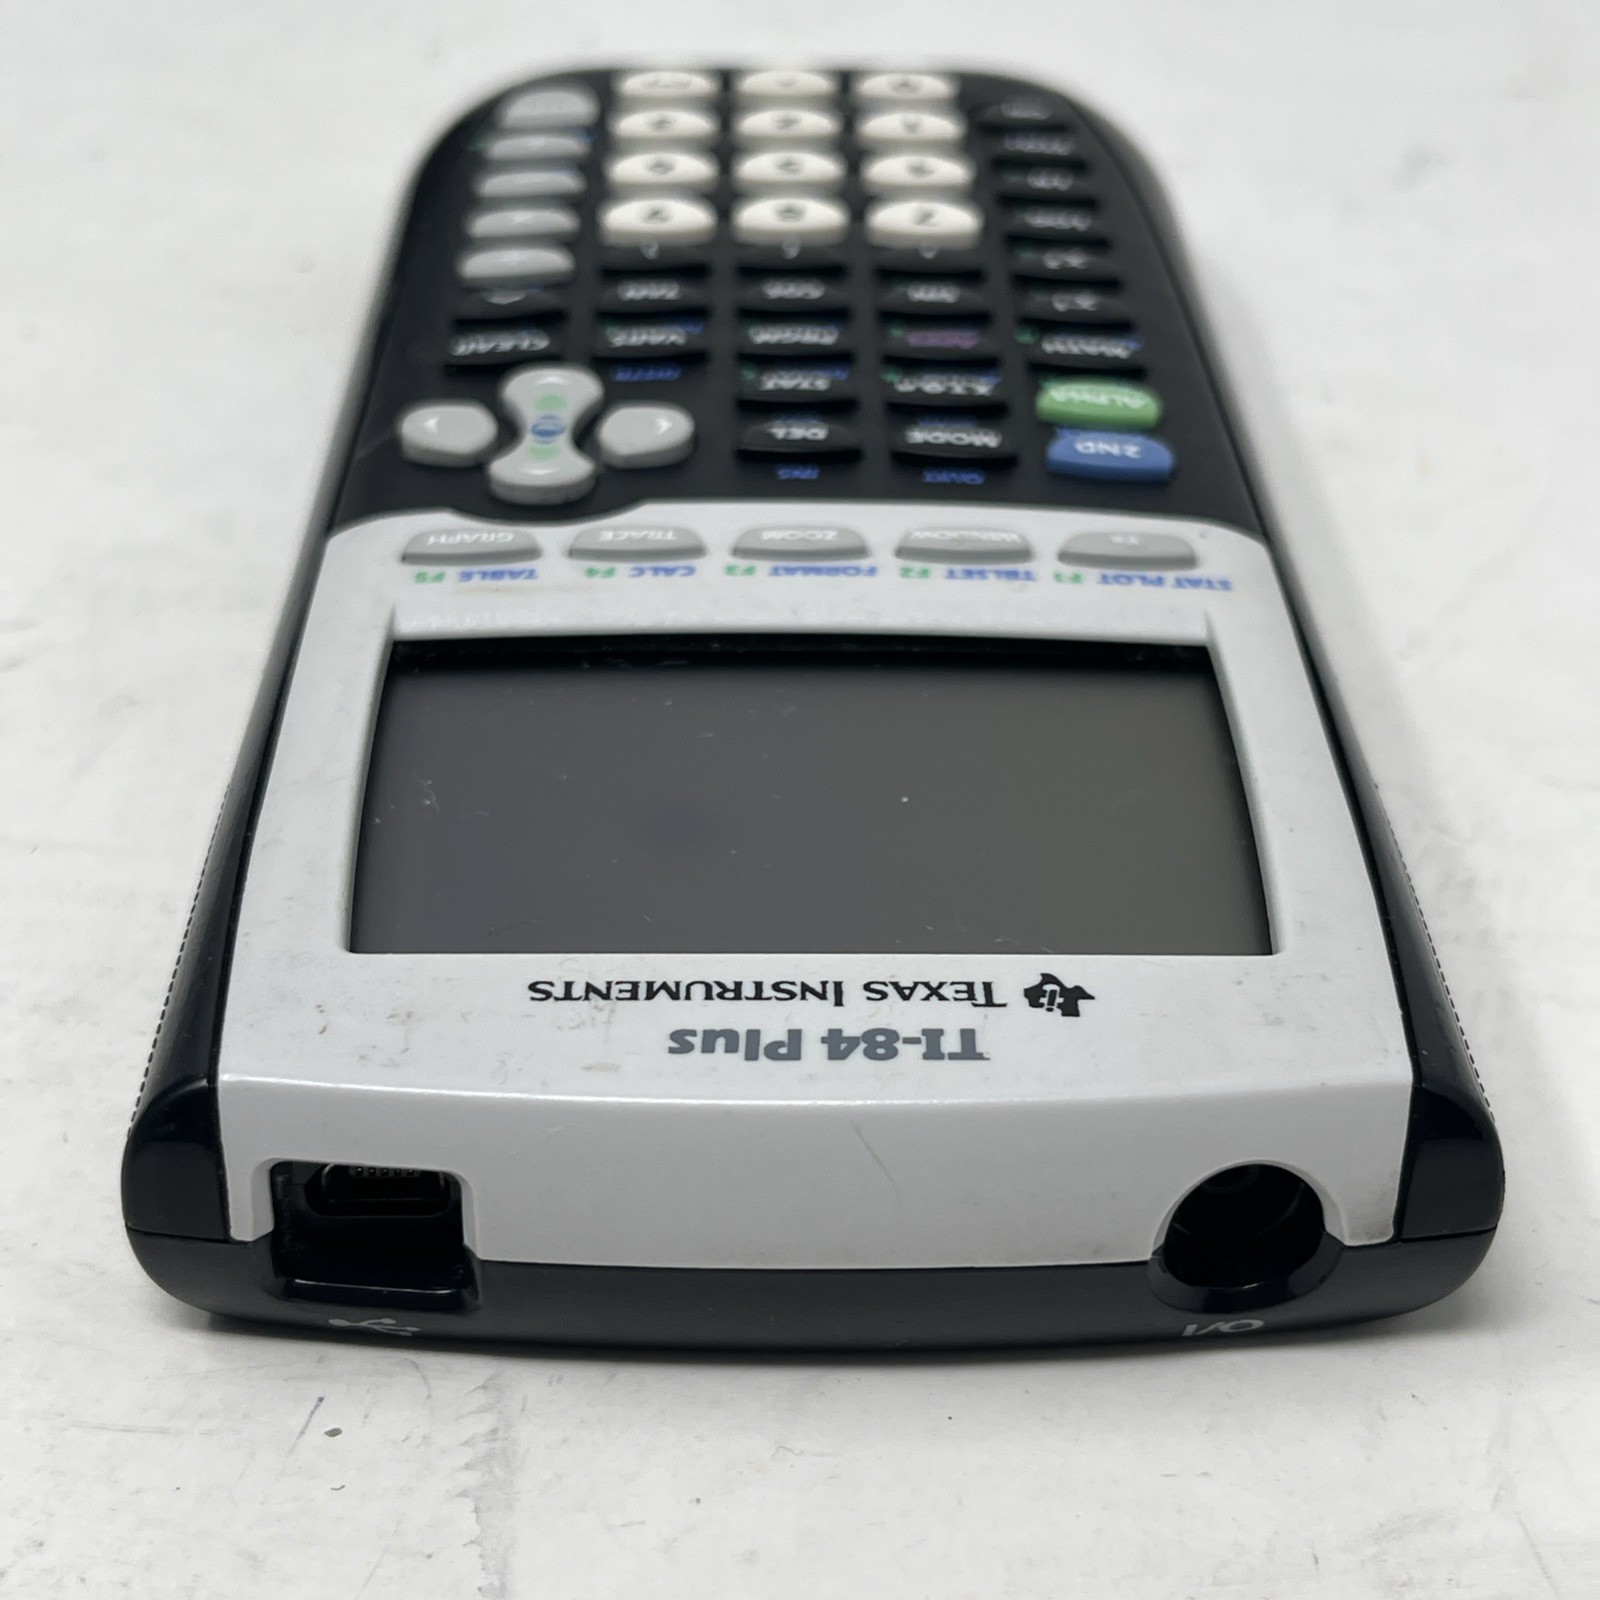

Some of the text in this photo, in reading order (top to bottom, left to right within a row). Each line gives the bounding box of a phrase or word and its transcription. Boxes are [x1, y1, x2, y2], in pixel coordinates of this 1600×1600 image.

[451, 330, 550, 356] CLEAR
[1050, 384, 1149, 409] ALPHA
[768, 423, 829, 441] DEL
[905, 427, 1001, 448] MODE
[1074, 440, 1141, 459] 2ND
[427, 532, 515, 546] GRAPH
[599, 530, 678, 542] TRACE
[761, 530, 839, 541] ZOOM
[413, 568, 538, 584] TABLE F5
[583, 565, 697, 579] CALC F4
[724, 565, 878, 577] FORMAT F3
[899, 566, 1036, 582] TBLSET F2
[1053, 570, 1233, 591] STAT PLOT F1
[527, 980, 1008, 1008] TEXAS INSTRUMENTS
[667, 1027, 991, 1061] TI-84 Plus
[1182, 1319, 1264, 1337] I/O
